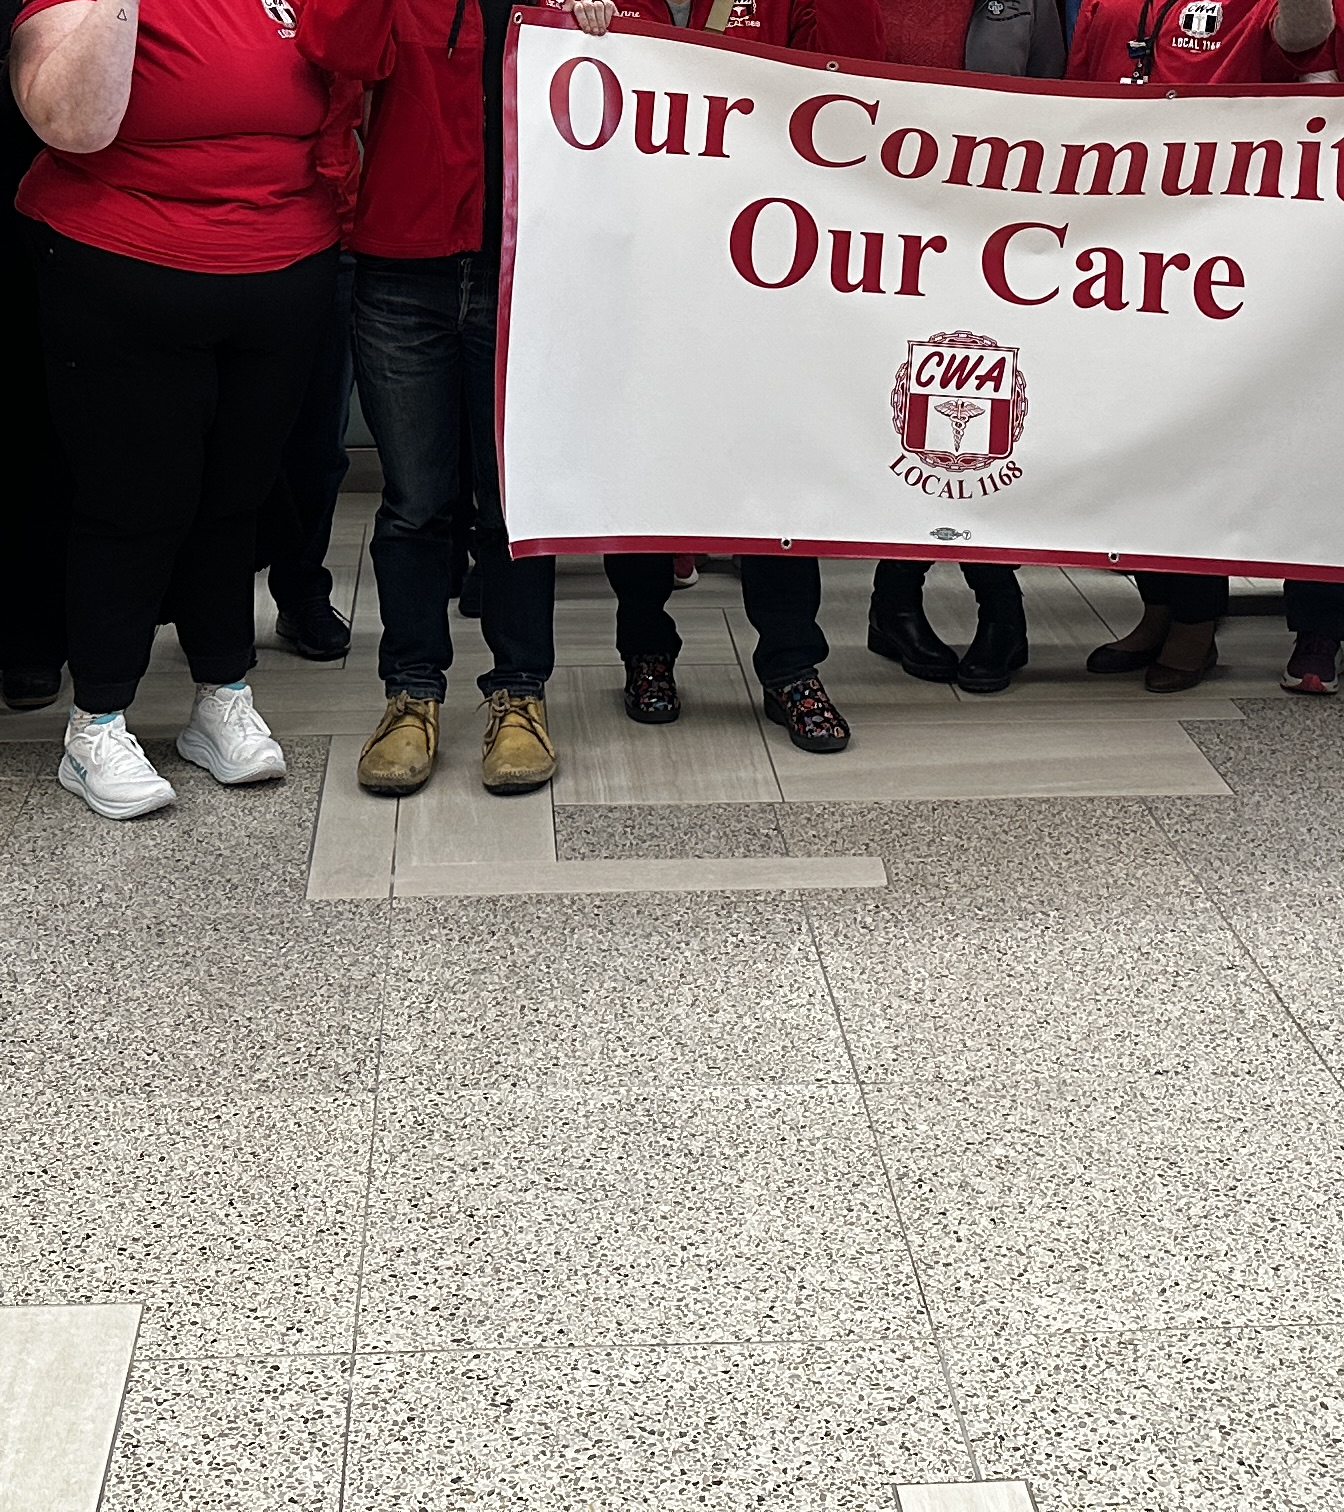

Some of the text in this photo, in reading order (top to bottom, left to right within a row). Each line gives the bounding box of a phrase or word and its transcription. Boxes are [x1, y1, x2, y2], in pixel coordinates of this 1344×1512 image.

[1187, 4, 1218, 14] CWA
[1171, 36, 1200, 50] LOCAL
[549, 57, 754, 158] Our
[729, 197, 1246, 320] Our Care
[915, 350, 1007, 393] CWA
[889, 453, 1024, 500] LOCAL 1168
